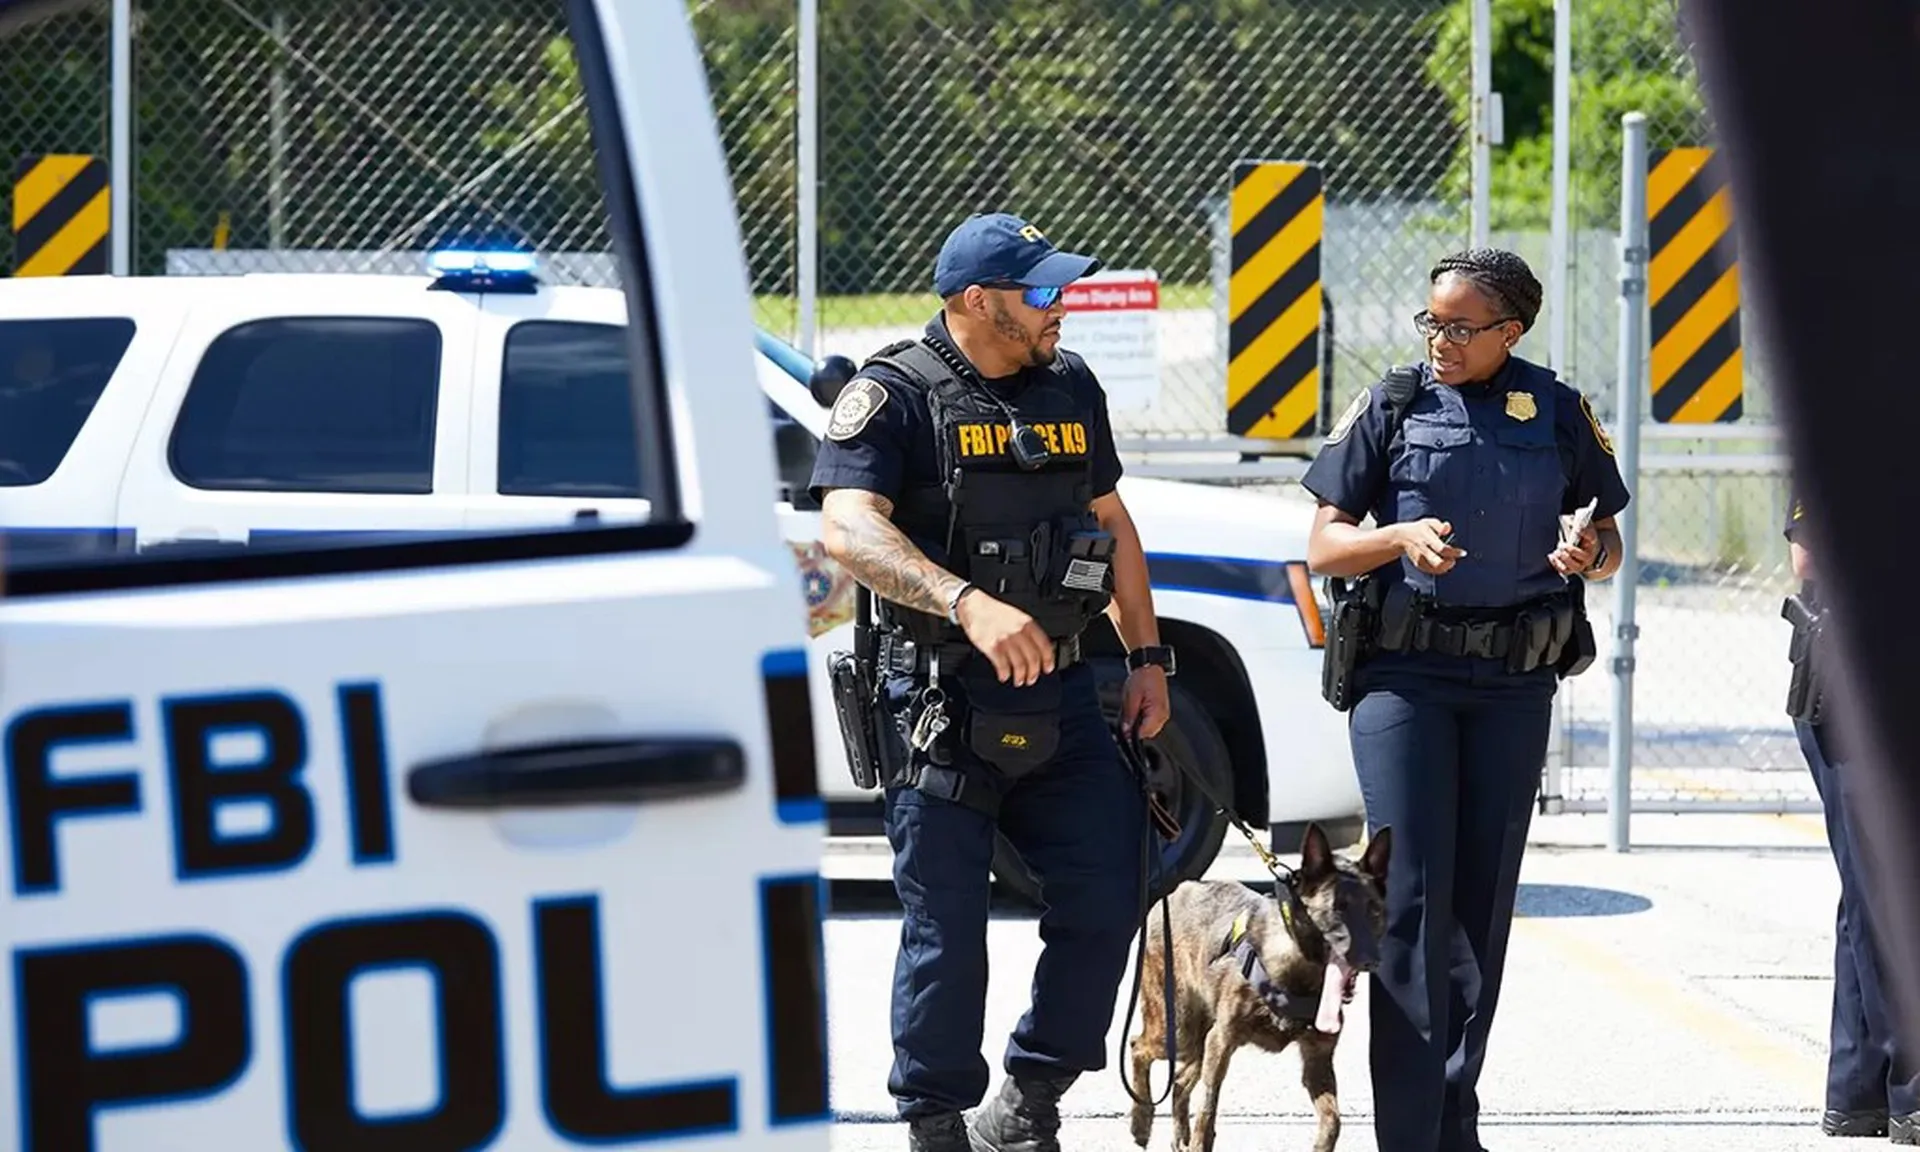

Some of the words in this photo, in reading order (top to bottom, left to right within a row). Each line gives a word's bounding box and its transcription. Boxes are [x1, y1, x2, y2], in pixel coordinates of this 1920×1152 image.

[958, 424, 995, 456] FBI
[994, 423, 1061, 455] PCE
[1060, 422, 1086, 454] K9
[2, 679, 398, 897] FBI
[12, 873, 830, 1152] POLI
